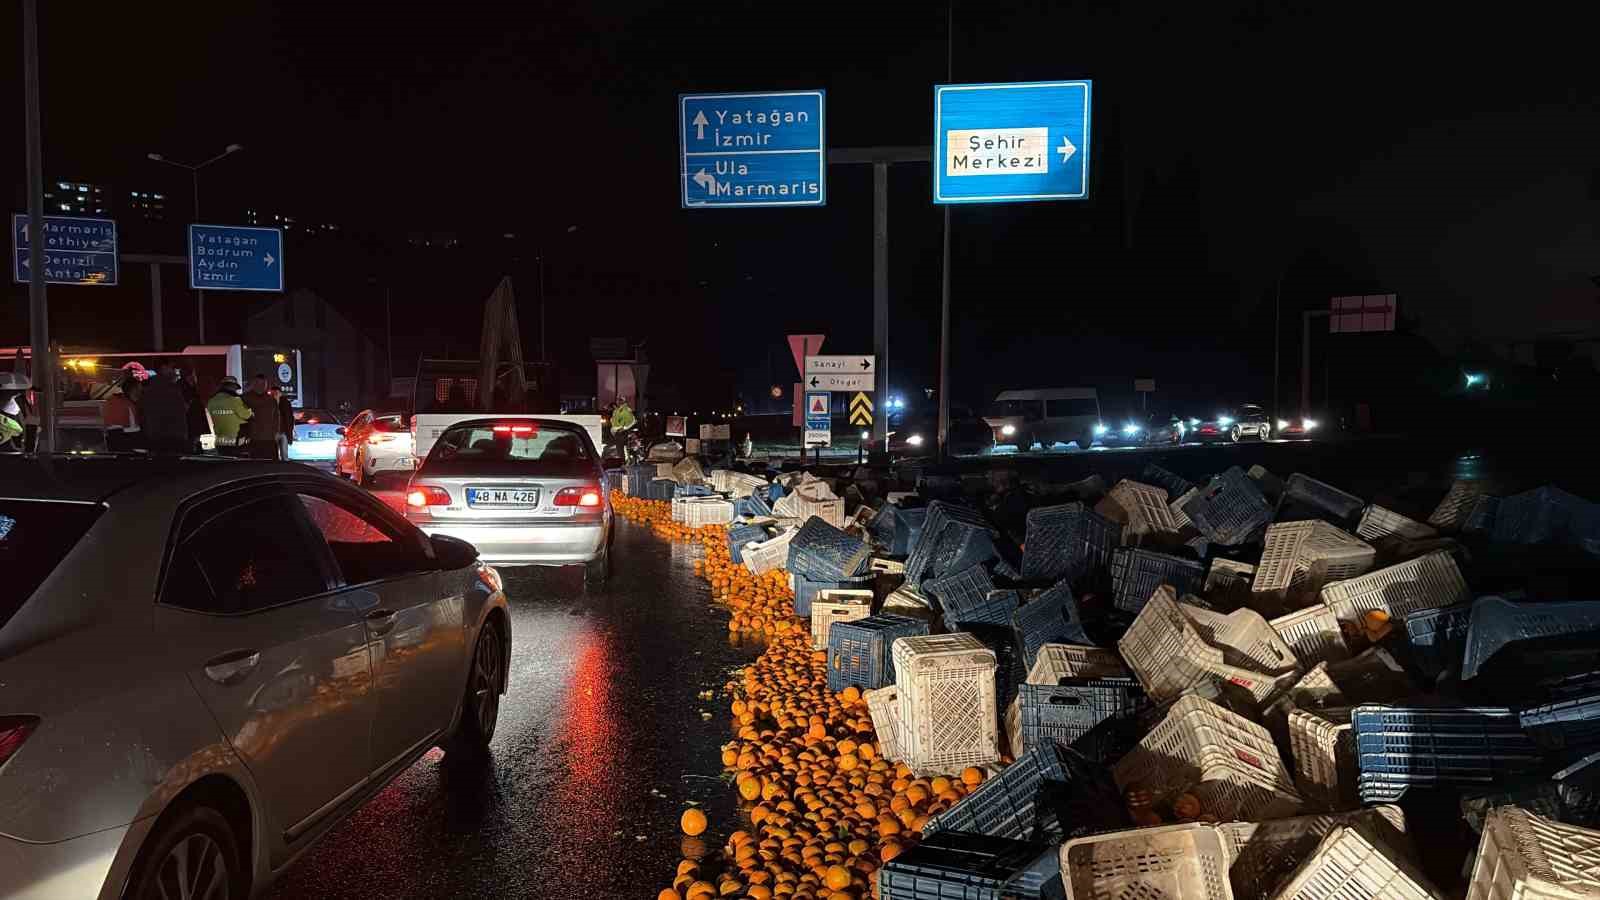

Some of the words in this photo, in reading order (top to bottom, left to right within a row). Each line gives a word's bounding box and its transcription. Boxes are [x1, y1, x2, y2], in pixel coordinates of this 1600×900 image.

[715, 109, 809, 126] Yatağan
[715, 128, 772, 147] İzmir
[969, 135, 1025, 153] Şehir
[715, 161, 748, 175] Ula
[953, 154, 1042, 169] Merkezi
[716, 182, 819, 197] Marmaris
[48, 236, 99, 248] ethiye
[197, 246, 254, 257] Bodrum
[198, 258, 239, 270] Aydın
[476, 491, 490, 502] 48
[514, 491, 535, 502] 426
